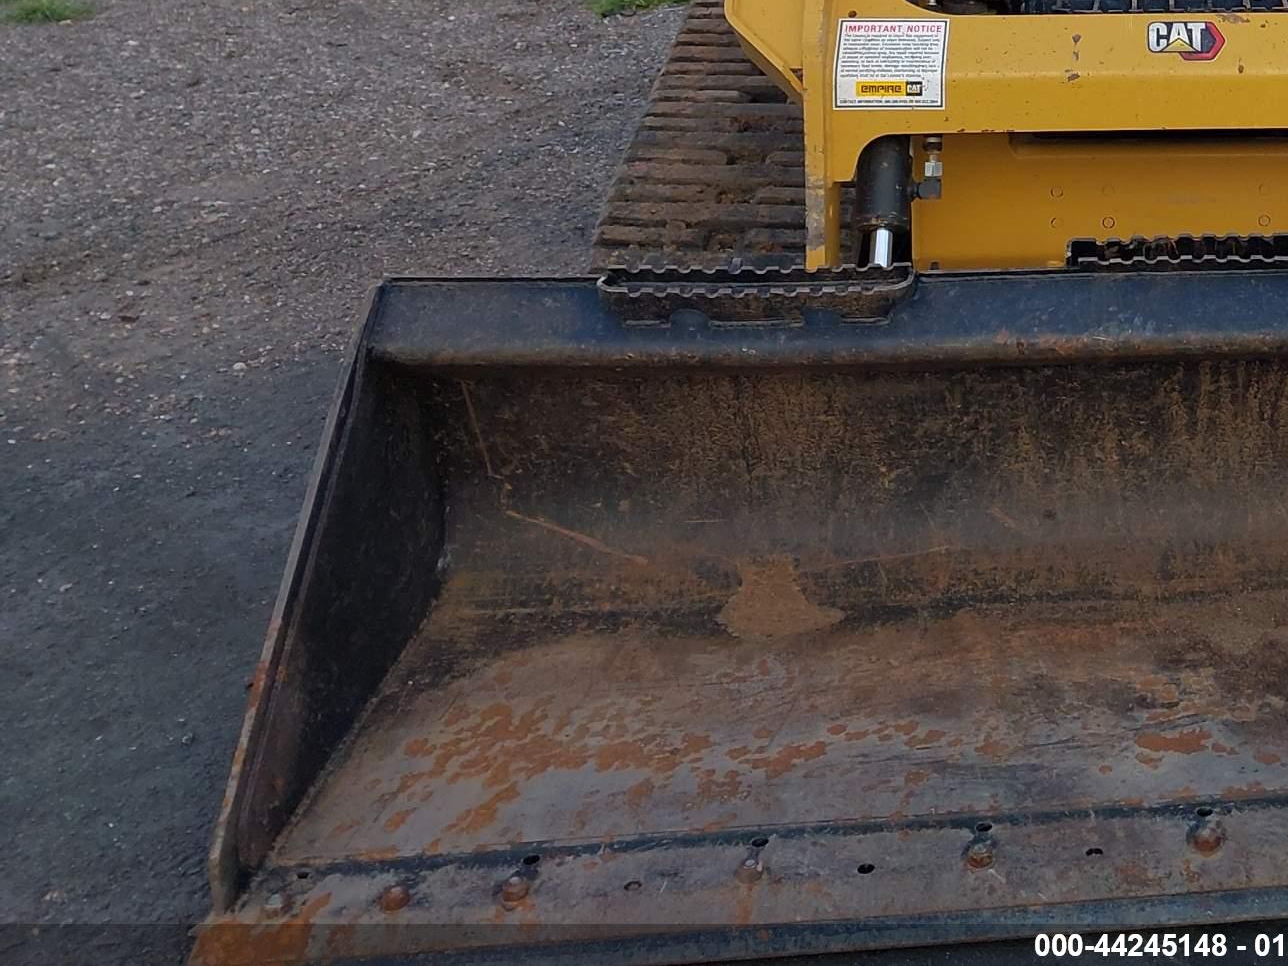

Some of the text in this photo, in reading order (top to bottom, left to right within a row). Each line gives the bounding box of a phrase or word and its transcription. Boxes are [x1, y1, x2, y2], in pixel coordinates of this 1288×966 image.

[844, 25, 942, 33] IMPORTANT NOTICE
[1148, 22, 1206, 52] CAT
[906, 84, 922, 93] CAT
